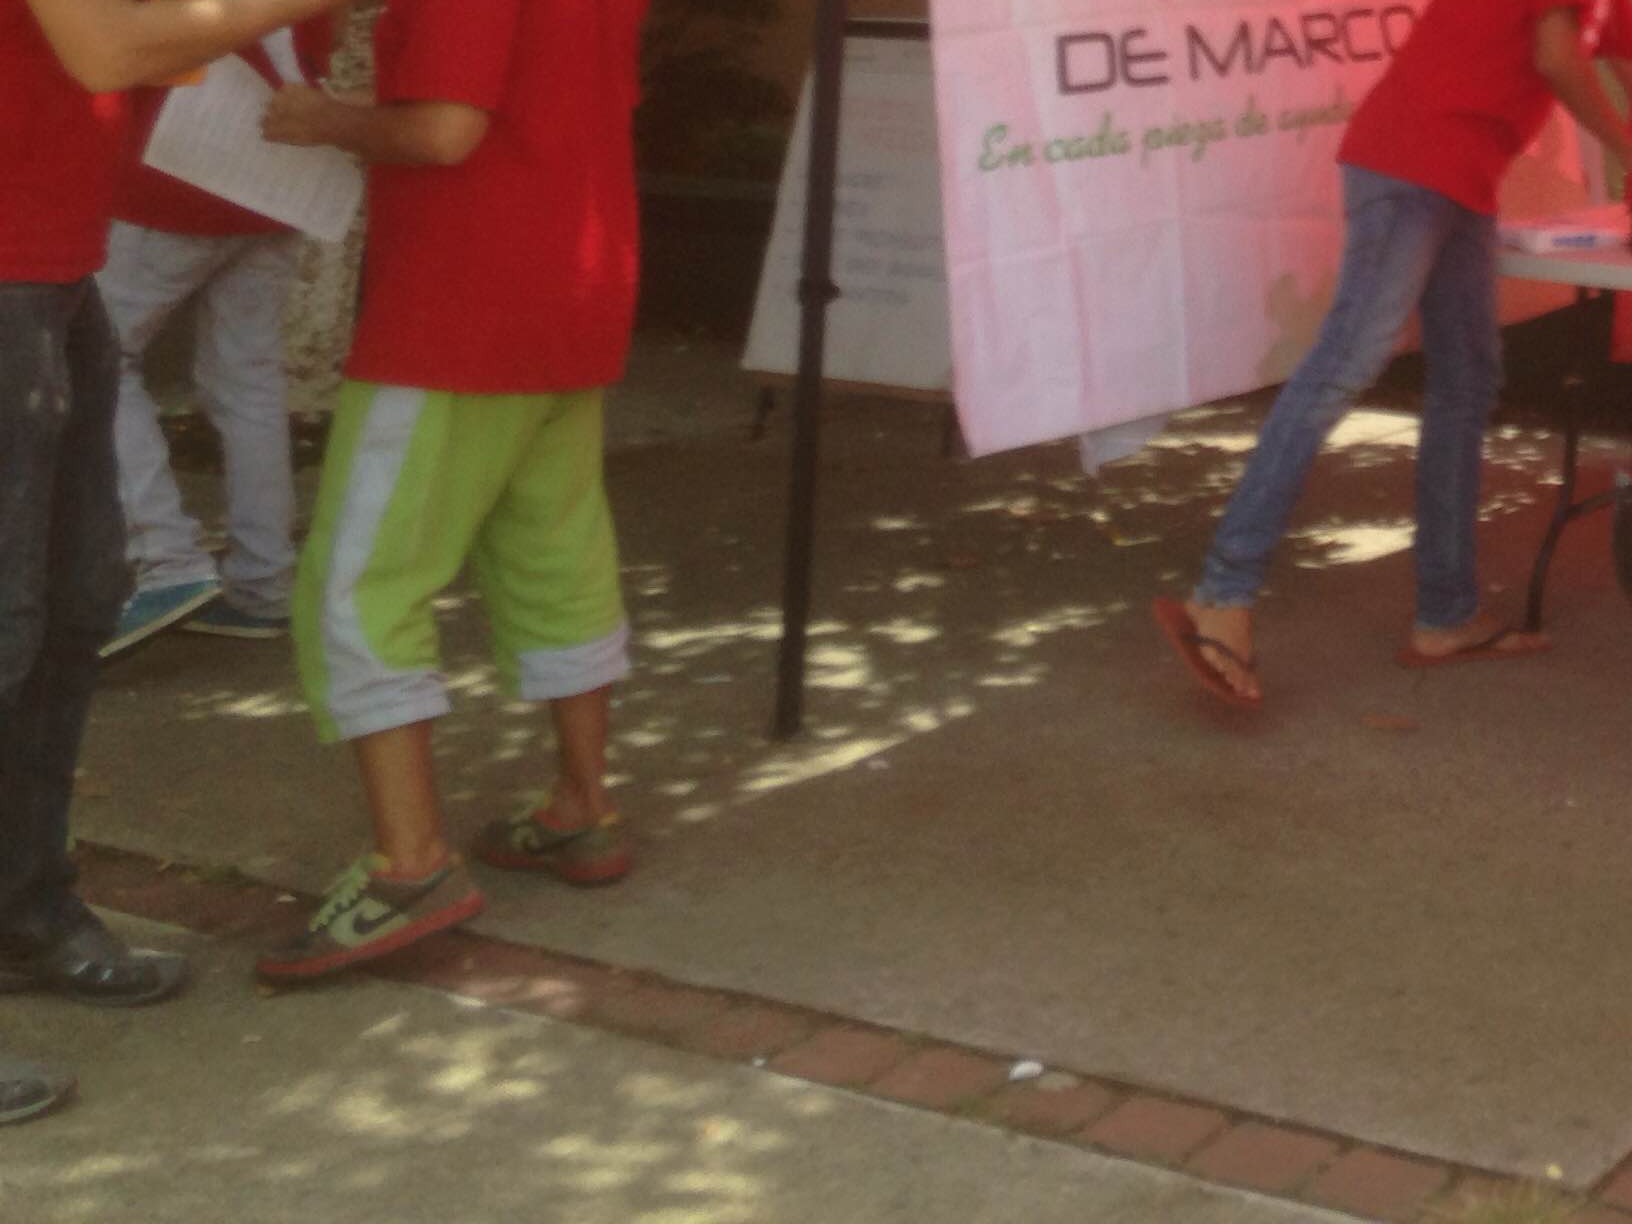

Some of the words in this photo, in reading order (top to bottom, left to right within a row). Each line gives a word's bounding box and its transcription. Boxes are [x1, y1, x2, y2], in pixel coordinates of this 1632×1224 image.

[1055, 28, 1168, 95] DE
[977, 121, 1034, 172] En
[1042, 110, 1132, 162] cada
[1234, 92, 1268, 138] de
